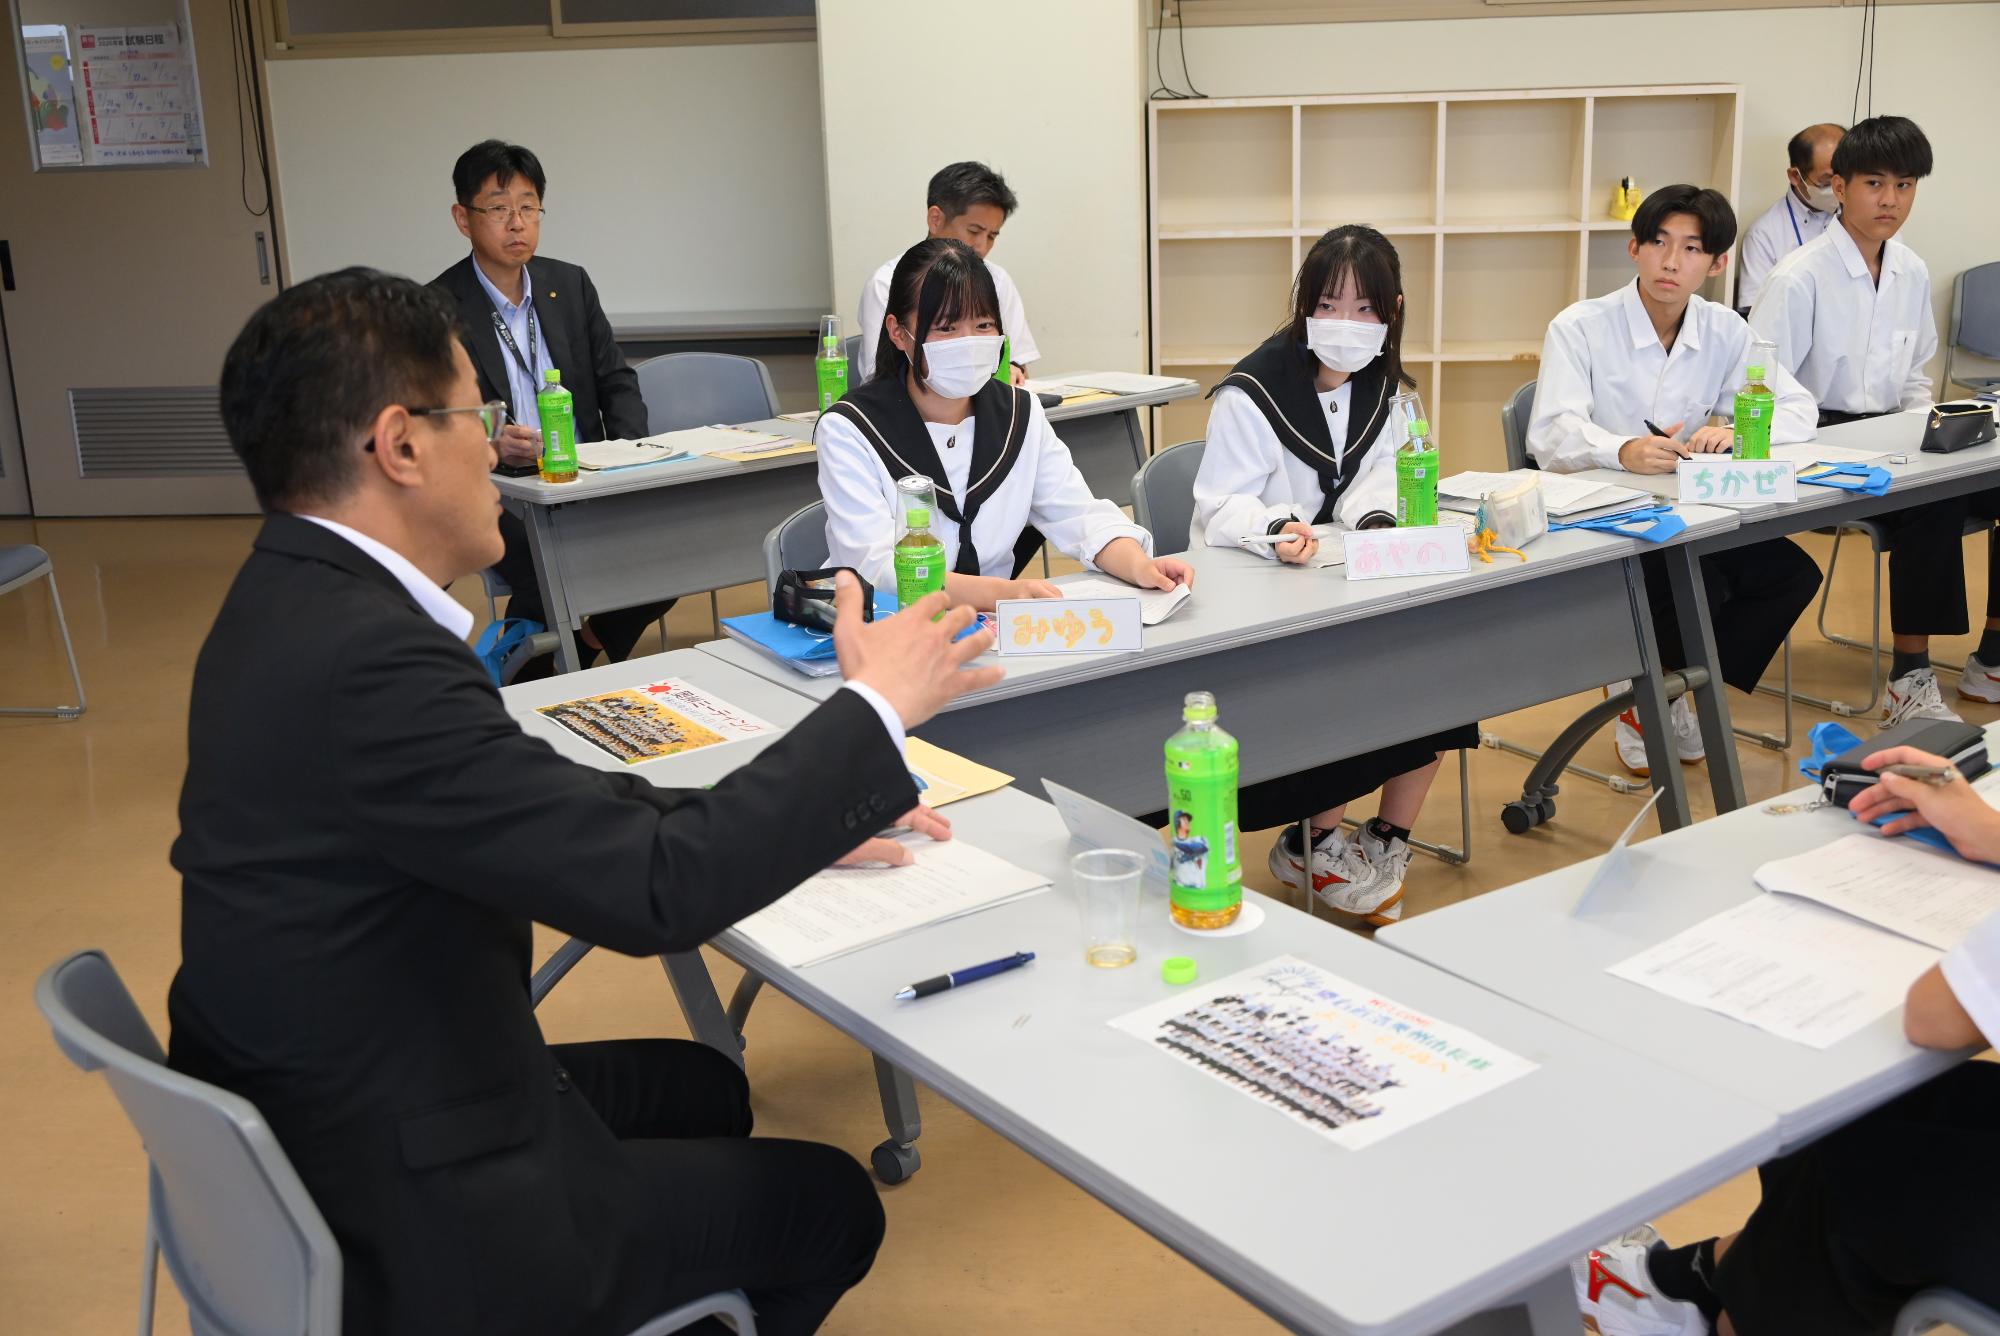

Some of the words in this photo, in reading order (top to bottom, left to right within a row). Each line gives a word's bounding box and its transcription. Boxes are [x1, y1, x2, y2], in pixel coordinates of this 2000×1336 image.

[125, 34, 164, 46] 試験日程
[1692, 465, 1789, 499] ちかぜ
[1354, 540, 1447, 573] あやの
[1012, 609, 1114, 649] みゆう
